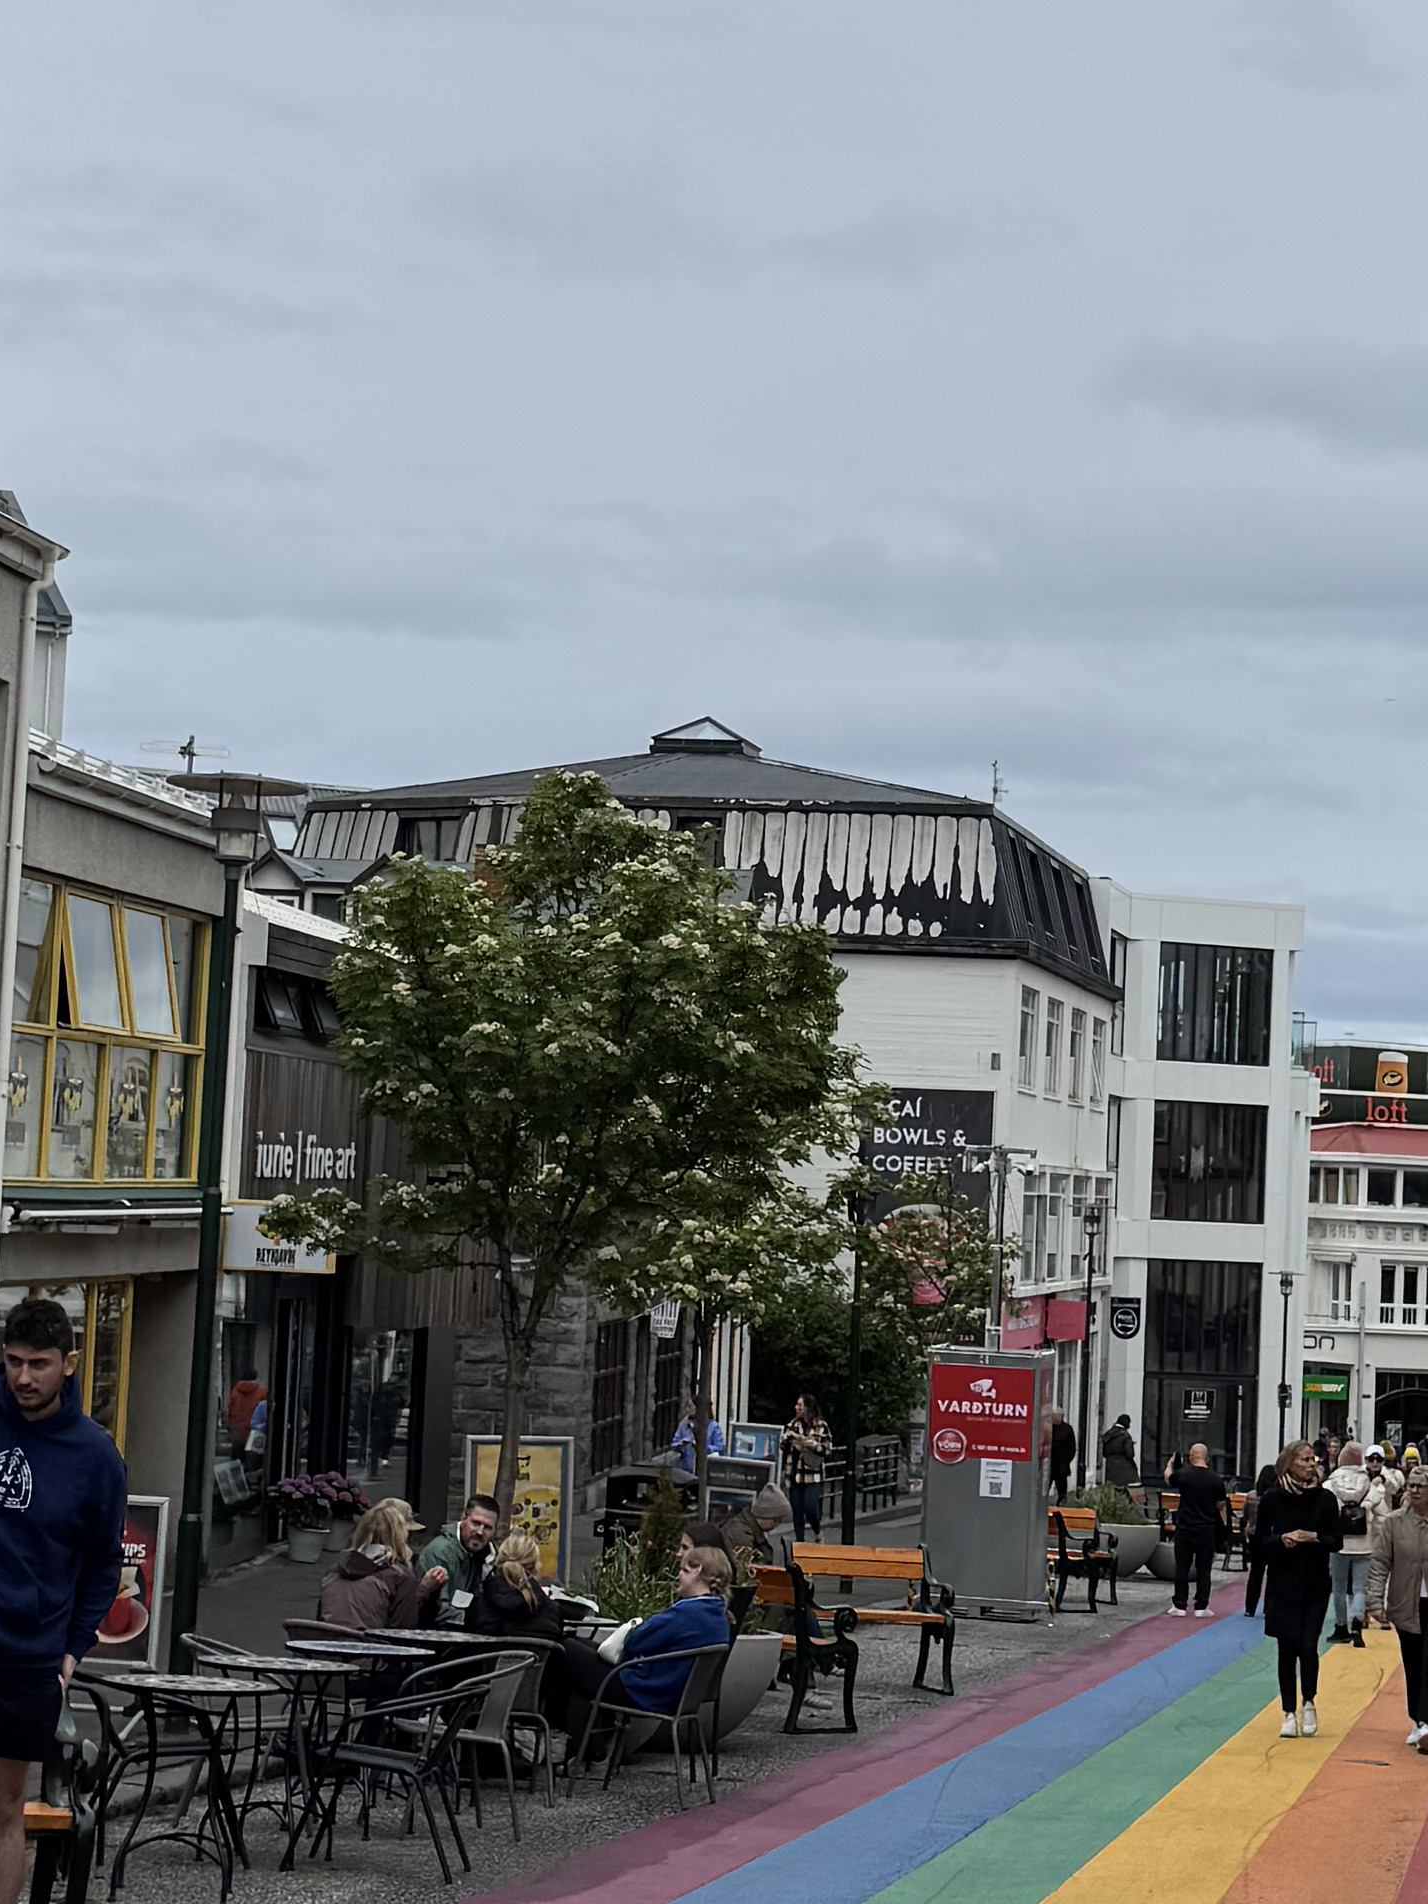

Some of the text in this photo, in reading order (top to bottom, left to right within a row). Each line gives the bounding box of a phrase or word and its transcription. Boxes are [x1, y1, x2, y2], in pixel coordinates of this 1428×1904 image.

[1365, 1097, 1407, 1122] loft
[873, 1127, 966, 1145] BOWLS &
[256, 1131, 293, 1178] iurie
[303, 1135, 333, 1179] fine
[336, 1142, 356, 1179] art
[938, 1399, 1027, 1417] VARÐTURN
